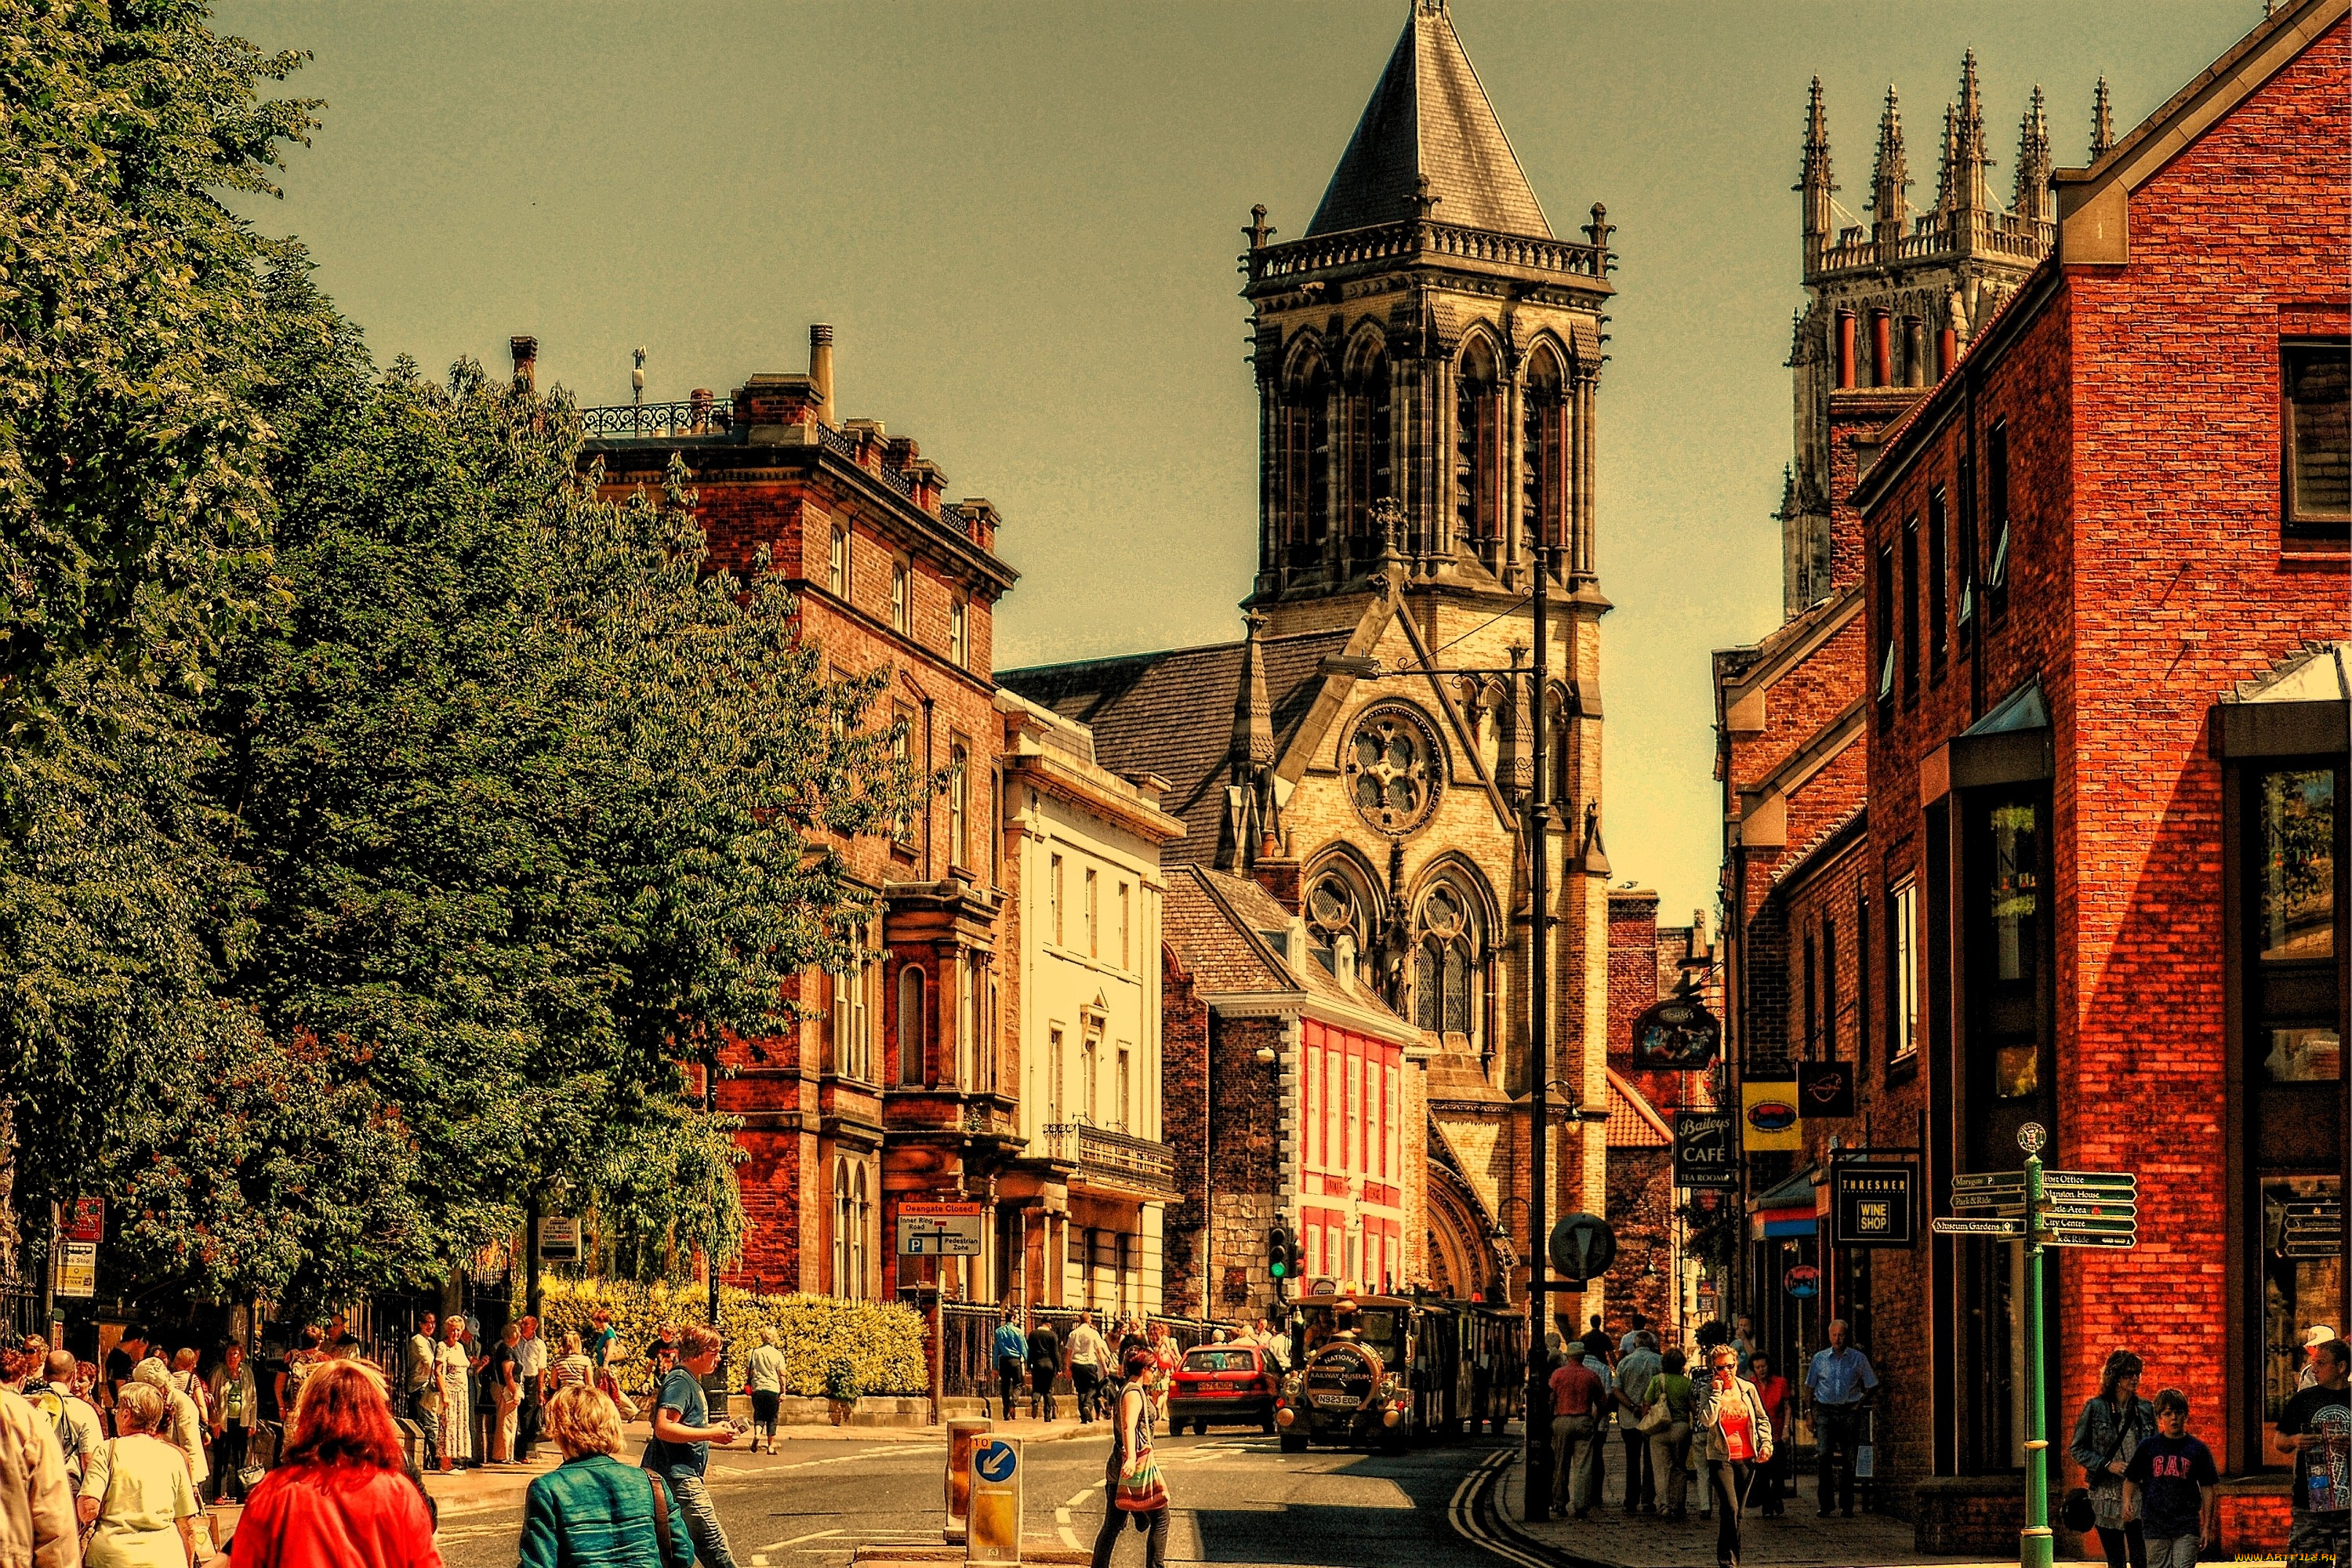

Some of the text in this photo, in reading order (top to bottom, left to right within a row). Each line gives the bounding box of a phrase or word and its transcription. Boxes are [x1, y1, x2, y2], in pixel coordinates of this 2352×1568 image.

[1679, 1116, 1730, 1136] Baileys
[1683, 1145, 1725, 1162] CAFÉ
[1955, 1178, 1984, 1188] Marygate
[2060, 1175, 2084, 1184] Office
[1842, 1180, 1905, 1190] THRESHER
[946, 1204, 974, 1213] Closed
[1860, 1203, 1887, 1216] WINE
[1860, 1217, 1887, 1229] SHOP
[1936, 1221, 1999, 1230] Museum Gardens
[2045, 1219, 2060, 1228] City
[2072, 1236, 2090, 1244] Ride
[911, 1240, 920, 1252] P
[1323, 1354, 1359, 1367] NATIONAL
[975, 1439, 989, 1447] 10
